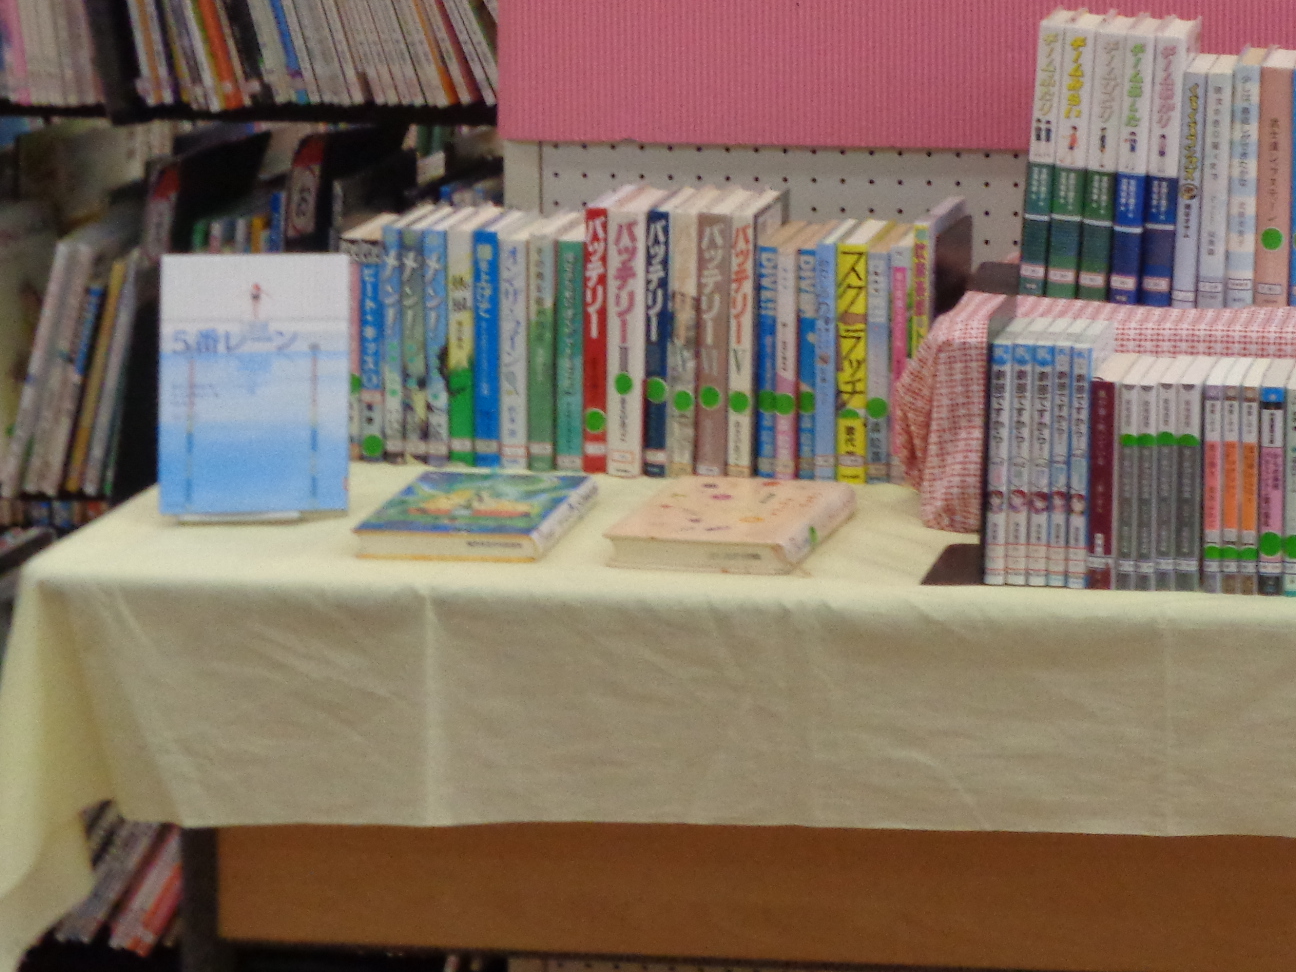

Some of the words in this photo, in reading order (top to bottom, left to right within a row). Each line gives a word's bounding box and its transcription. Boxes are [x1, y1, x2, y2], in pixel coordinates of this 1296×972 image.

[586, 215, 605, 340] バッテリー
[614, 220, 639, 344] バッテリー
[647, 218, 666, 342] バッテリー
[700, 222, 724, 346] バッテリー
[731, 224, 750, 345] バッテリー
[838, 250, 867, 406] スクラッチ
